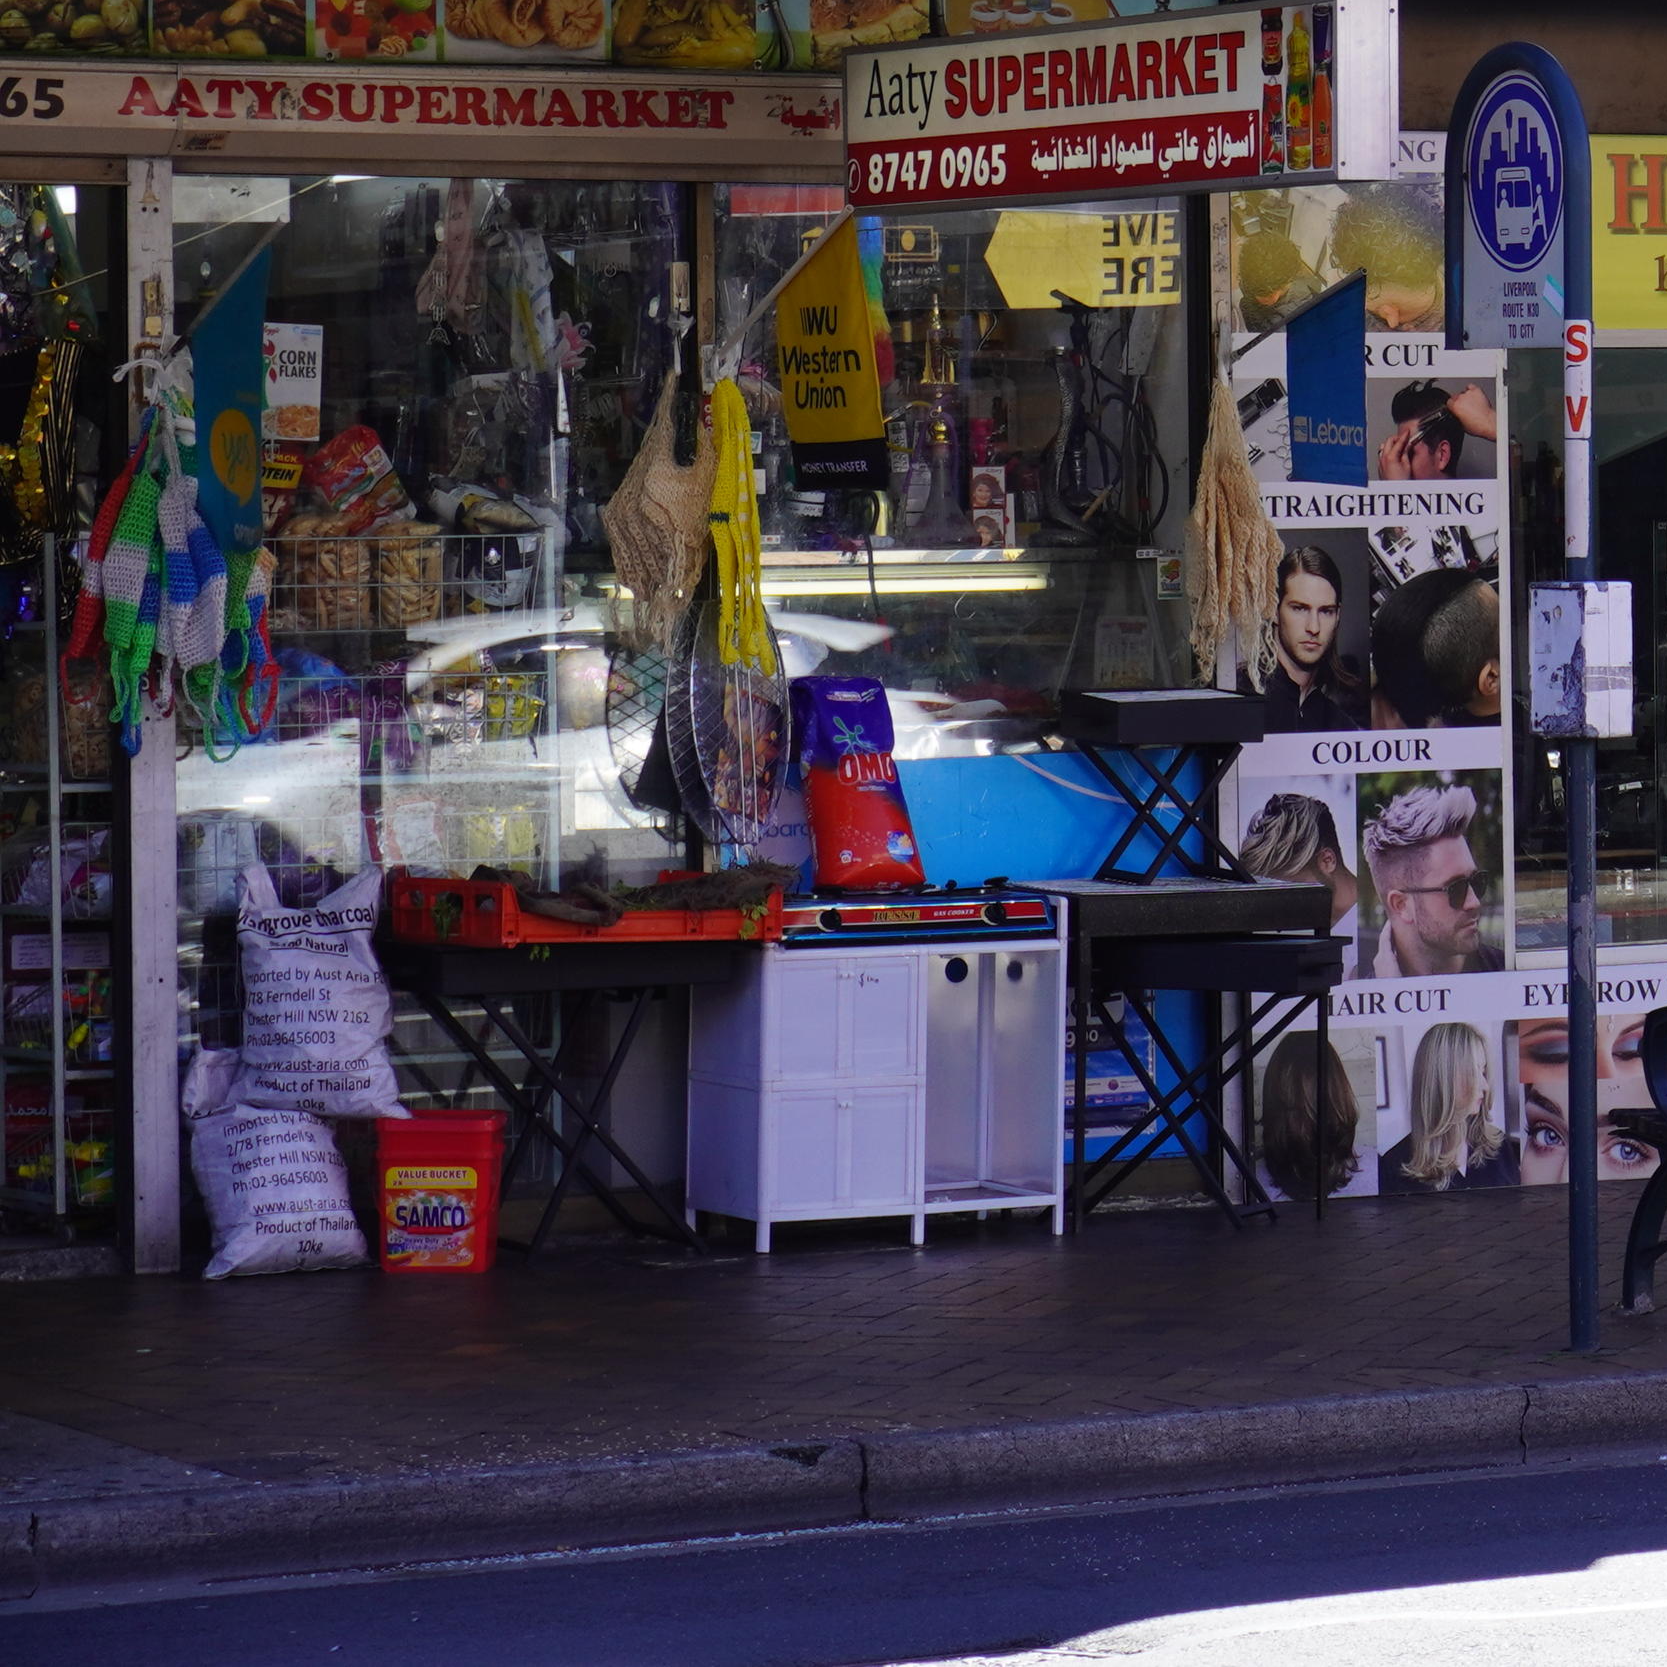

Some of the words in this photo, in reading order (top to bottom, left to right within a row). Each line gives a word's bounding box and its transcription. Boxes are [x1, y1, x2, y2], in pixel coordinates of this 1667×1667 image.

[864, 58, 938, 131] Aaty
[944, 31, 1246, 120] SUPERMARKET
[117, 76, 287, 120] AATY
[301, 82, 734, 131] SUPERMARKET
[1101, 131, 1155, 174] للمواد
[1158, 127, 1200, 179] عاتي
[1203, 113, 1256, 168] أسواق
[867, 149, 934, 195] 8747
[940, 143, 1007, 189] 0965
[1031, 133, 1098, 179] الغذائية
[1503, 281, 1538, 298] LIVERPOOL
[1502, 303, 1525, 319] ROUTE
[1508, 324, 1518, 340] TO
[1519, 322, 1536, 340] CITY
[278, 349, 317, 366] CORN
[782, 344, 861, 376] Western
[1382, 344, 1439, 368] CUT
[278, 364, 317, 380] FLAKES
[794, 376, 846, 410] Union
[1308, 415, 1364, 447] Lebara
[825, 459, 868, 473] TRANSFER
[1258, 491, 1486, 519] TRAIGHTENING
[1312, 738, 1433, 766] COLOUR
[837, 750, 897, 785] OMO
[266, 987, 315, 1004] Ferndell
[1394, 988, 1452, 1015] CUT
[284, 1009, 304, 1024] Hill
[307, 1009, 339, 1024] NSW
[317, 1076, 371, 1092] Thailand
[395, 1205, 466, 1230] SAMCO
